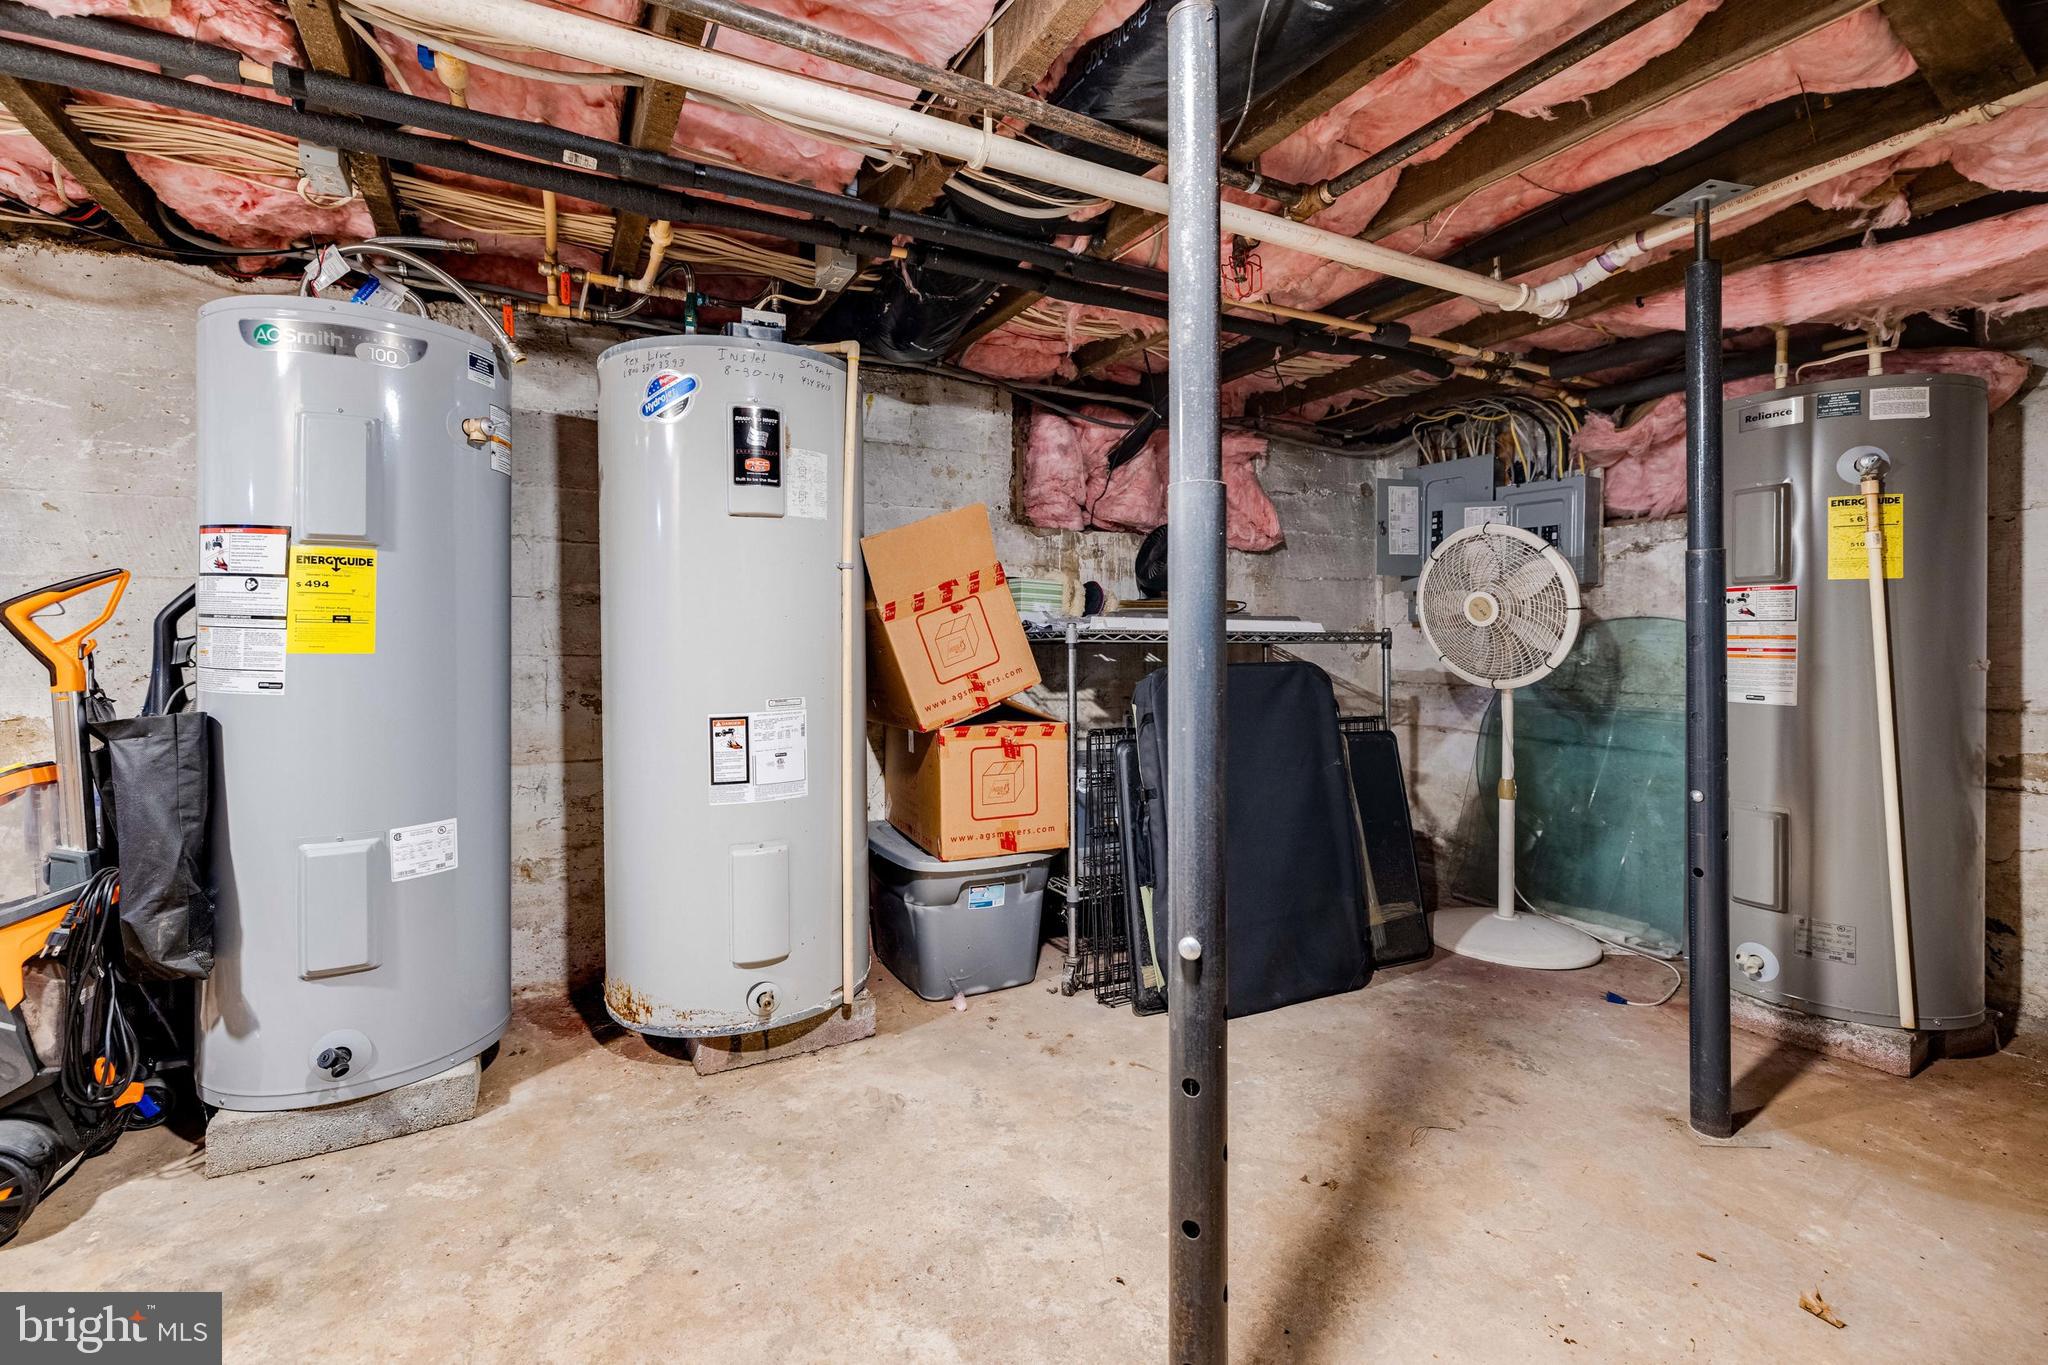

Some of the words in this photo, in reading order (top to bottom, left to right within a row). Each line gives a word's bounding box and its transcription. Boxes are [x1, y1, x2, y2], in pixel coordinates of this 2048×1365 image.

[369, 347, 398, 364] 100
[1744, 408, 1793, 424] Reliance
[296, 555, 374, 571] ENERGYGUIDE
[304, 580, 330, 588] 494
